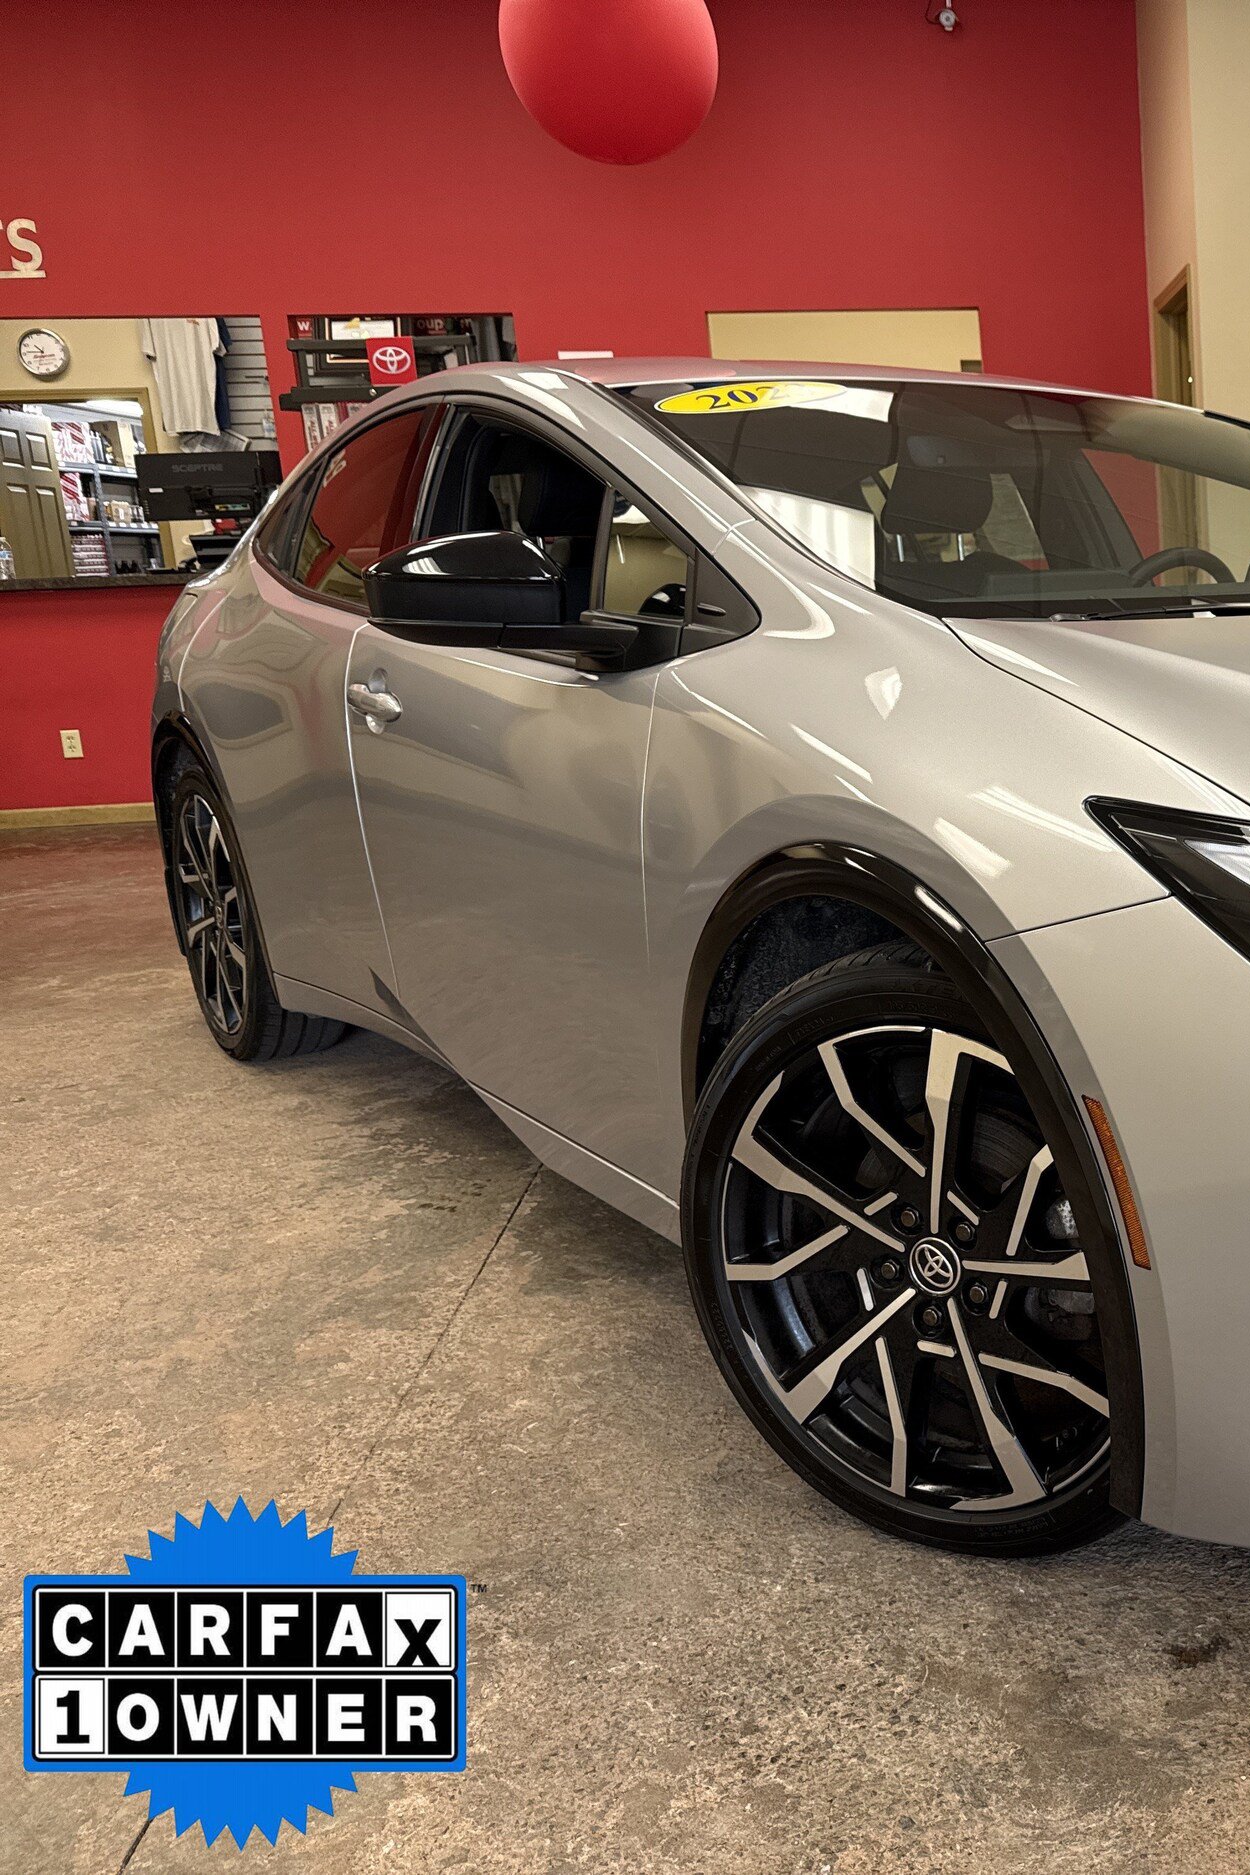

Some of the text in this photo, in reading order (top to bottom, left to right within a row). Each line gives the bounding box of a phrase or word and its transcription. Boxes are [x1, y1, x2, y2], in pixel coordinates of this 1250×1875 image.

[0, 218, 43, 271] S
[695, 383, 806, 410] 202
[171, 463, 223, 473] SCEPTRE
